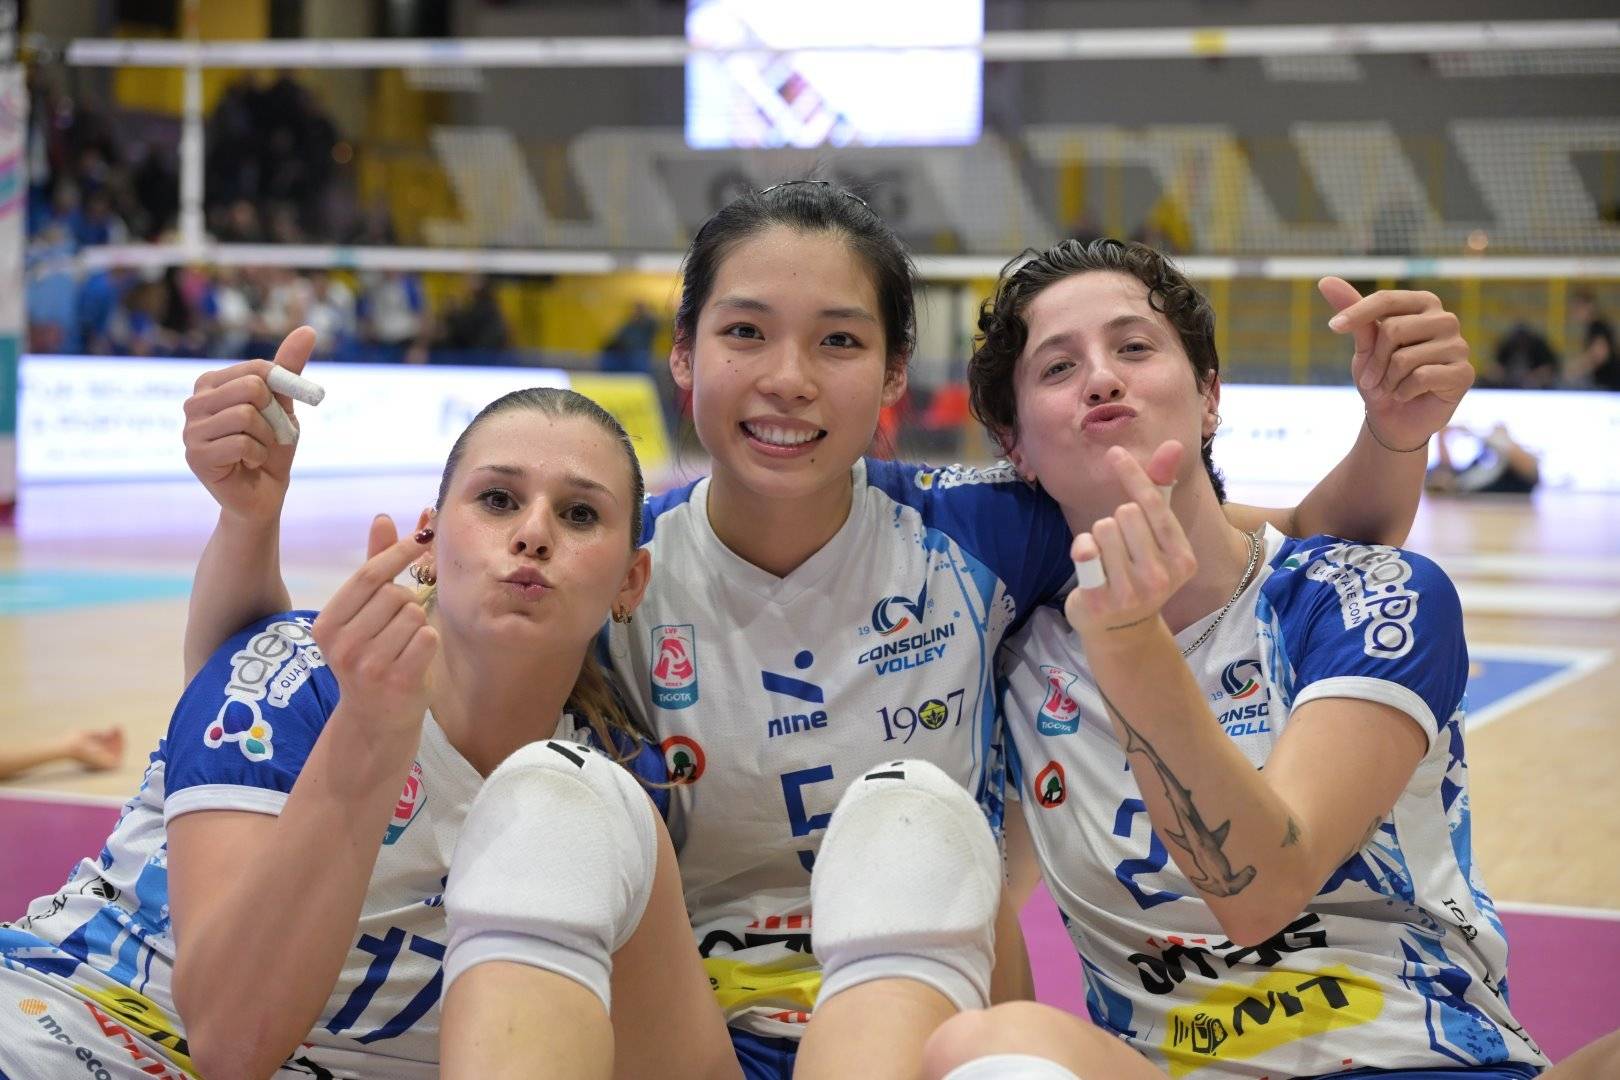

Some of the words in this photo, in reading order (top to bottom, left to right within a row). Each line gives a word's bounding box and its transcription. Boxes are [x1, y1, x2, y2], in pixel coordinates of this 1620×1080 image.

[857, 622, 956, 665] CONSOLINI
[875, 643, 947, 676] VOLLEY
[768, 709, 828, 738] nine
[876, 688, 966, 745] 1907
[325, 926, 447, 1045] 17
